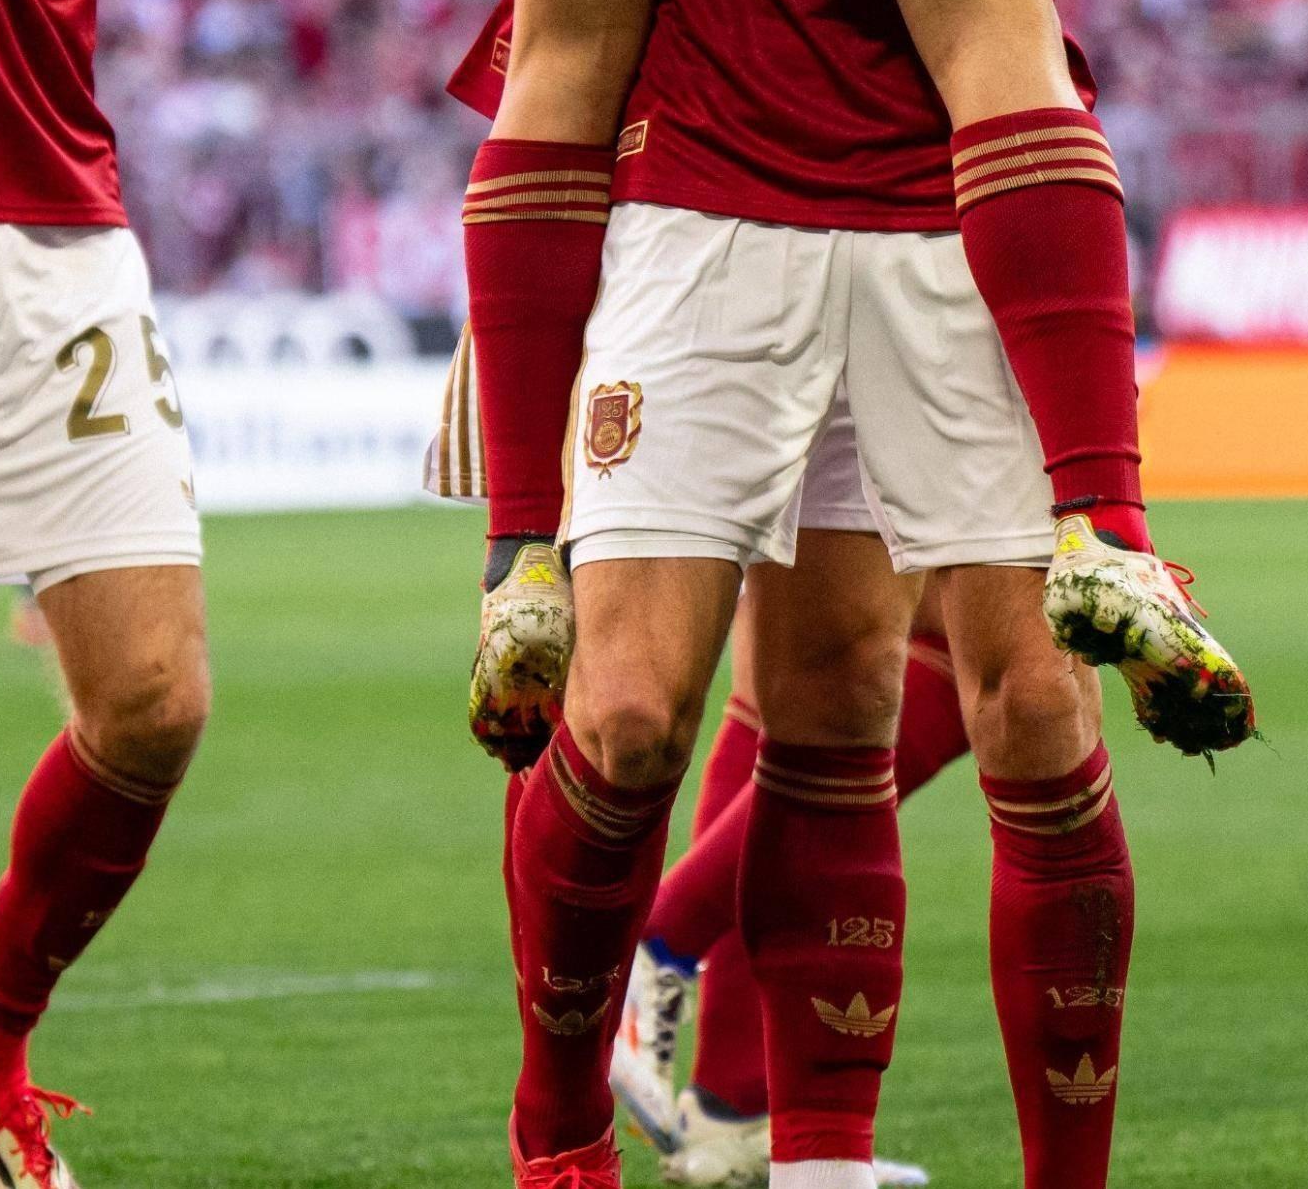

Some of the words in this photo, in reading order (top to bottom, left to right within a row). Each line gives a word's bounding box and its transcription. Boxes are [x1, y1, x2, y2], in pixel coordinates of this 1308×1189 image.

[55, 315, 184, 445] 25
[826, 916, 895, 949] 125
[1045, 986, 1124, 1009] 125
